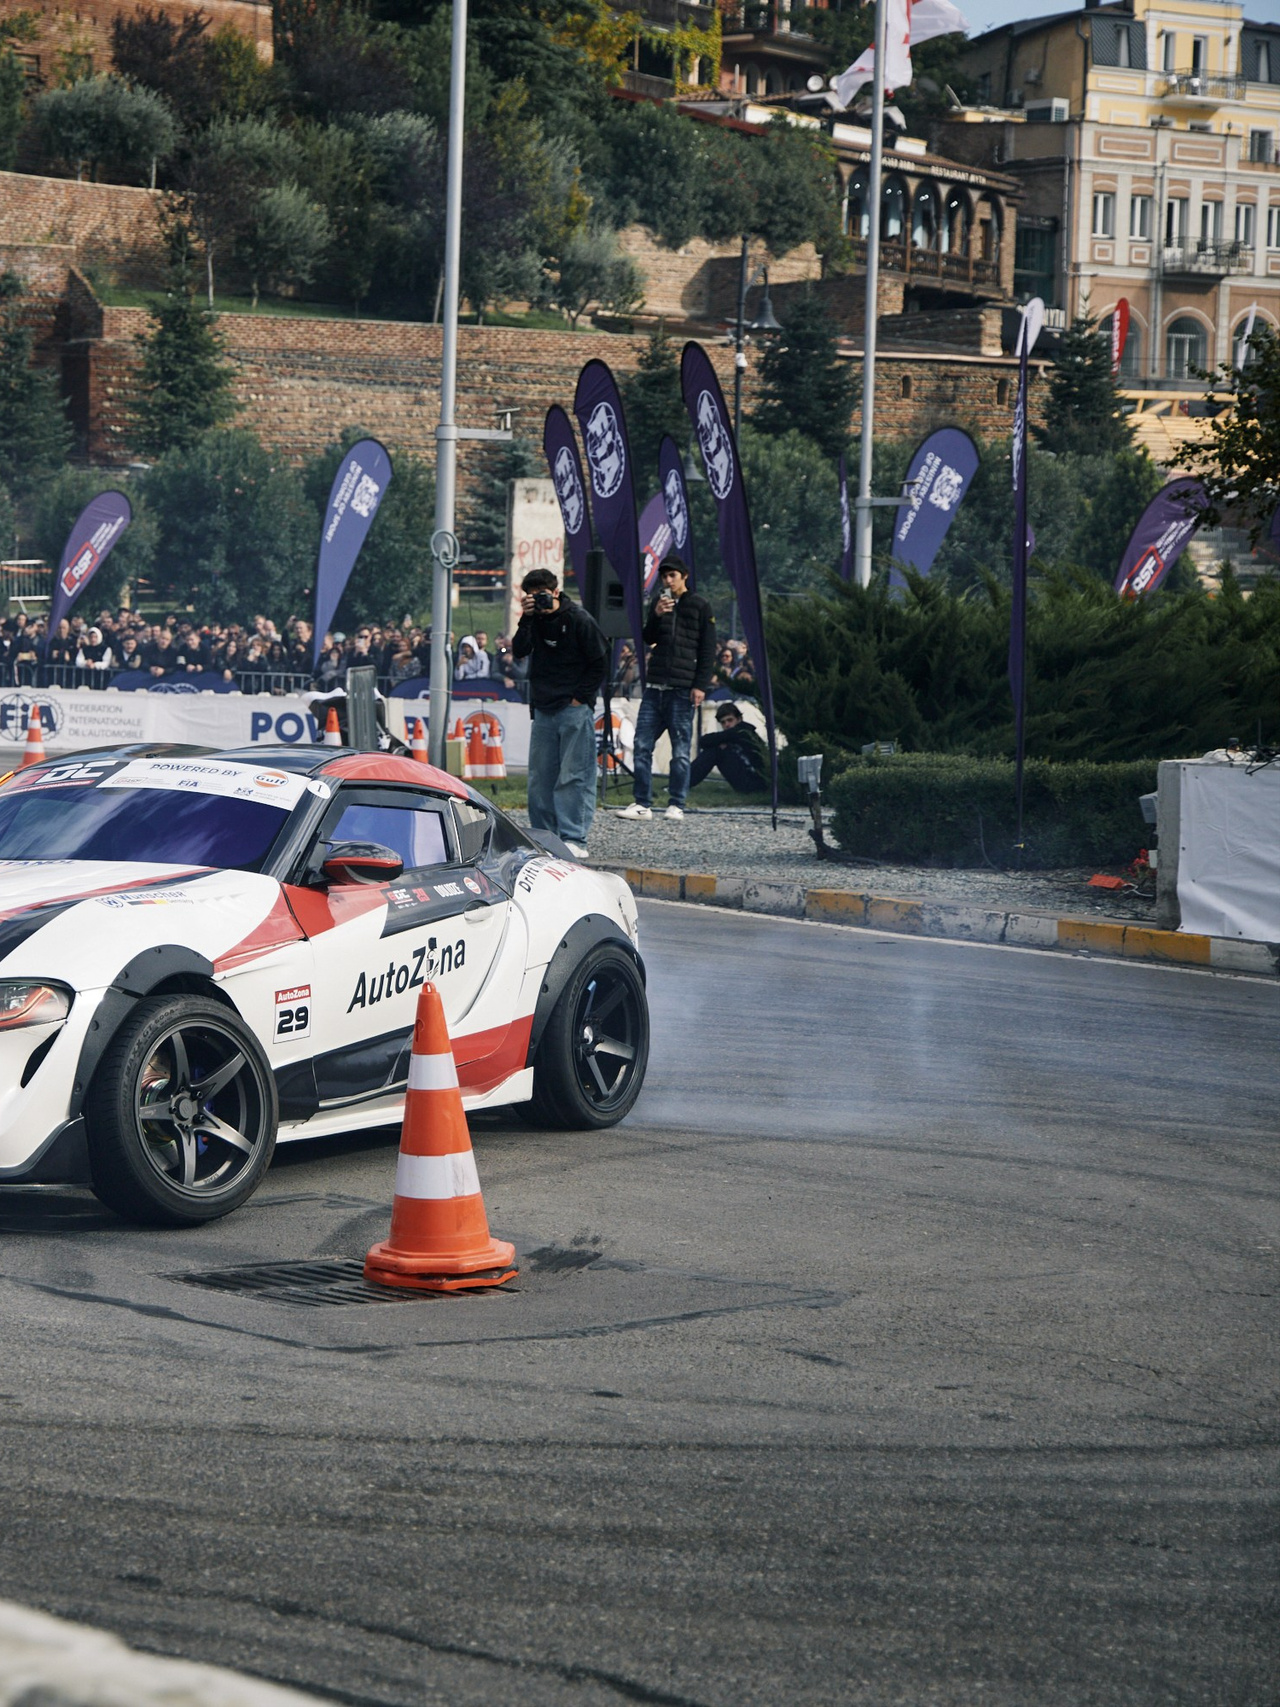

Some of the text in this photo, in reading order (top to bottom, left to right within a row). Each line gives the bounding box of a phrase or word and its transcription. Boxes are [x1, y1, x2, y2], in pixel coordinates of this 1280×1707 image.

[925, 452, 935, 466] OF
[919, 456, 942, 498] MINISTRY
[898, 510, 916, 541] SPORT
[69, 704, 123, 713] FEDERATION
[70, 716, 142, 726] INTERNATIONALE
[150, 764, 222, 774] POWERED
[256, 775, 287, 785] Gulf
[518, 865, 540, 893] Drift
[278, 986, 310, 1003] AutoZona
[277, 1005, 309, 1035] 29
